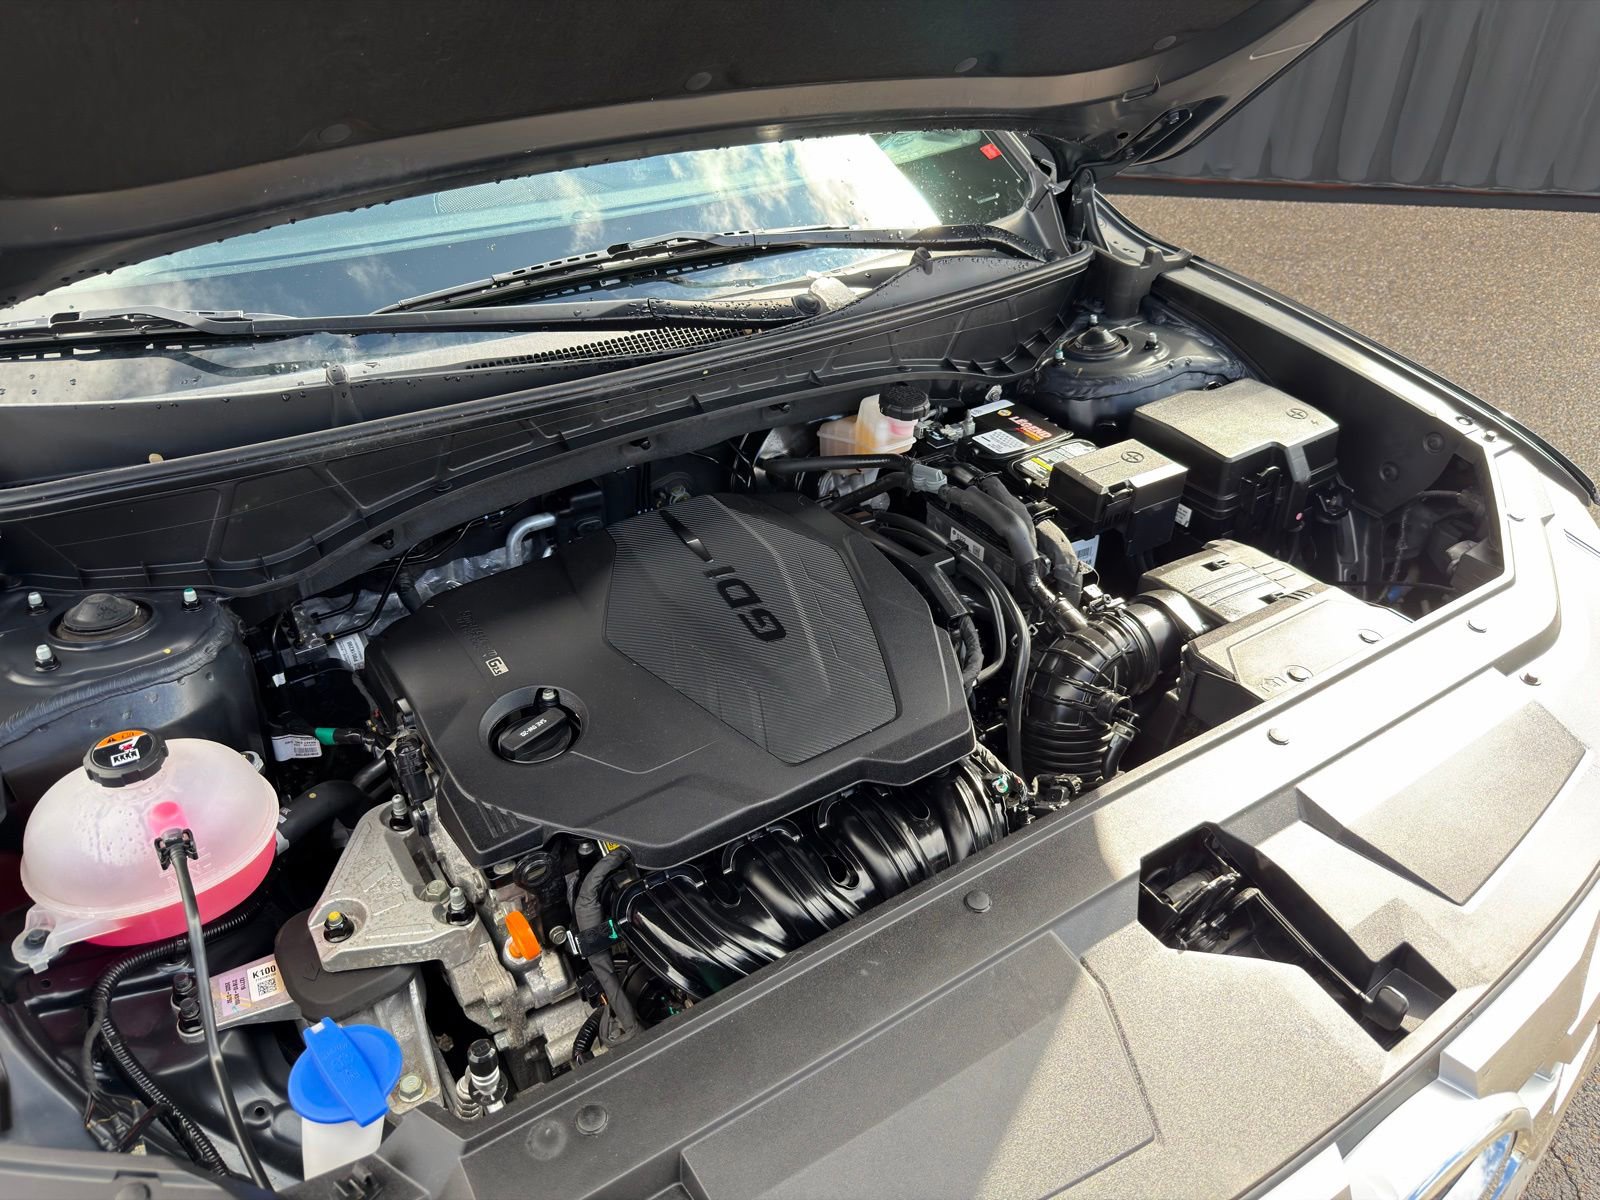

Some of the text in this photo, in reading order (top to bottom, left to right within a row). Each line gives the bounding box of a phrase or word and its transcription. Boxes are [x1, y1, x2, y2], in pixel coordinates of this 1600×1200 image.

[1008, 416, 1052, 438] LEGEND
[703, 565, 787, 643] GDI
[252, 965, 276, 979] K100
